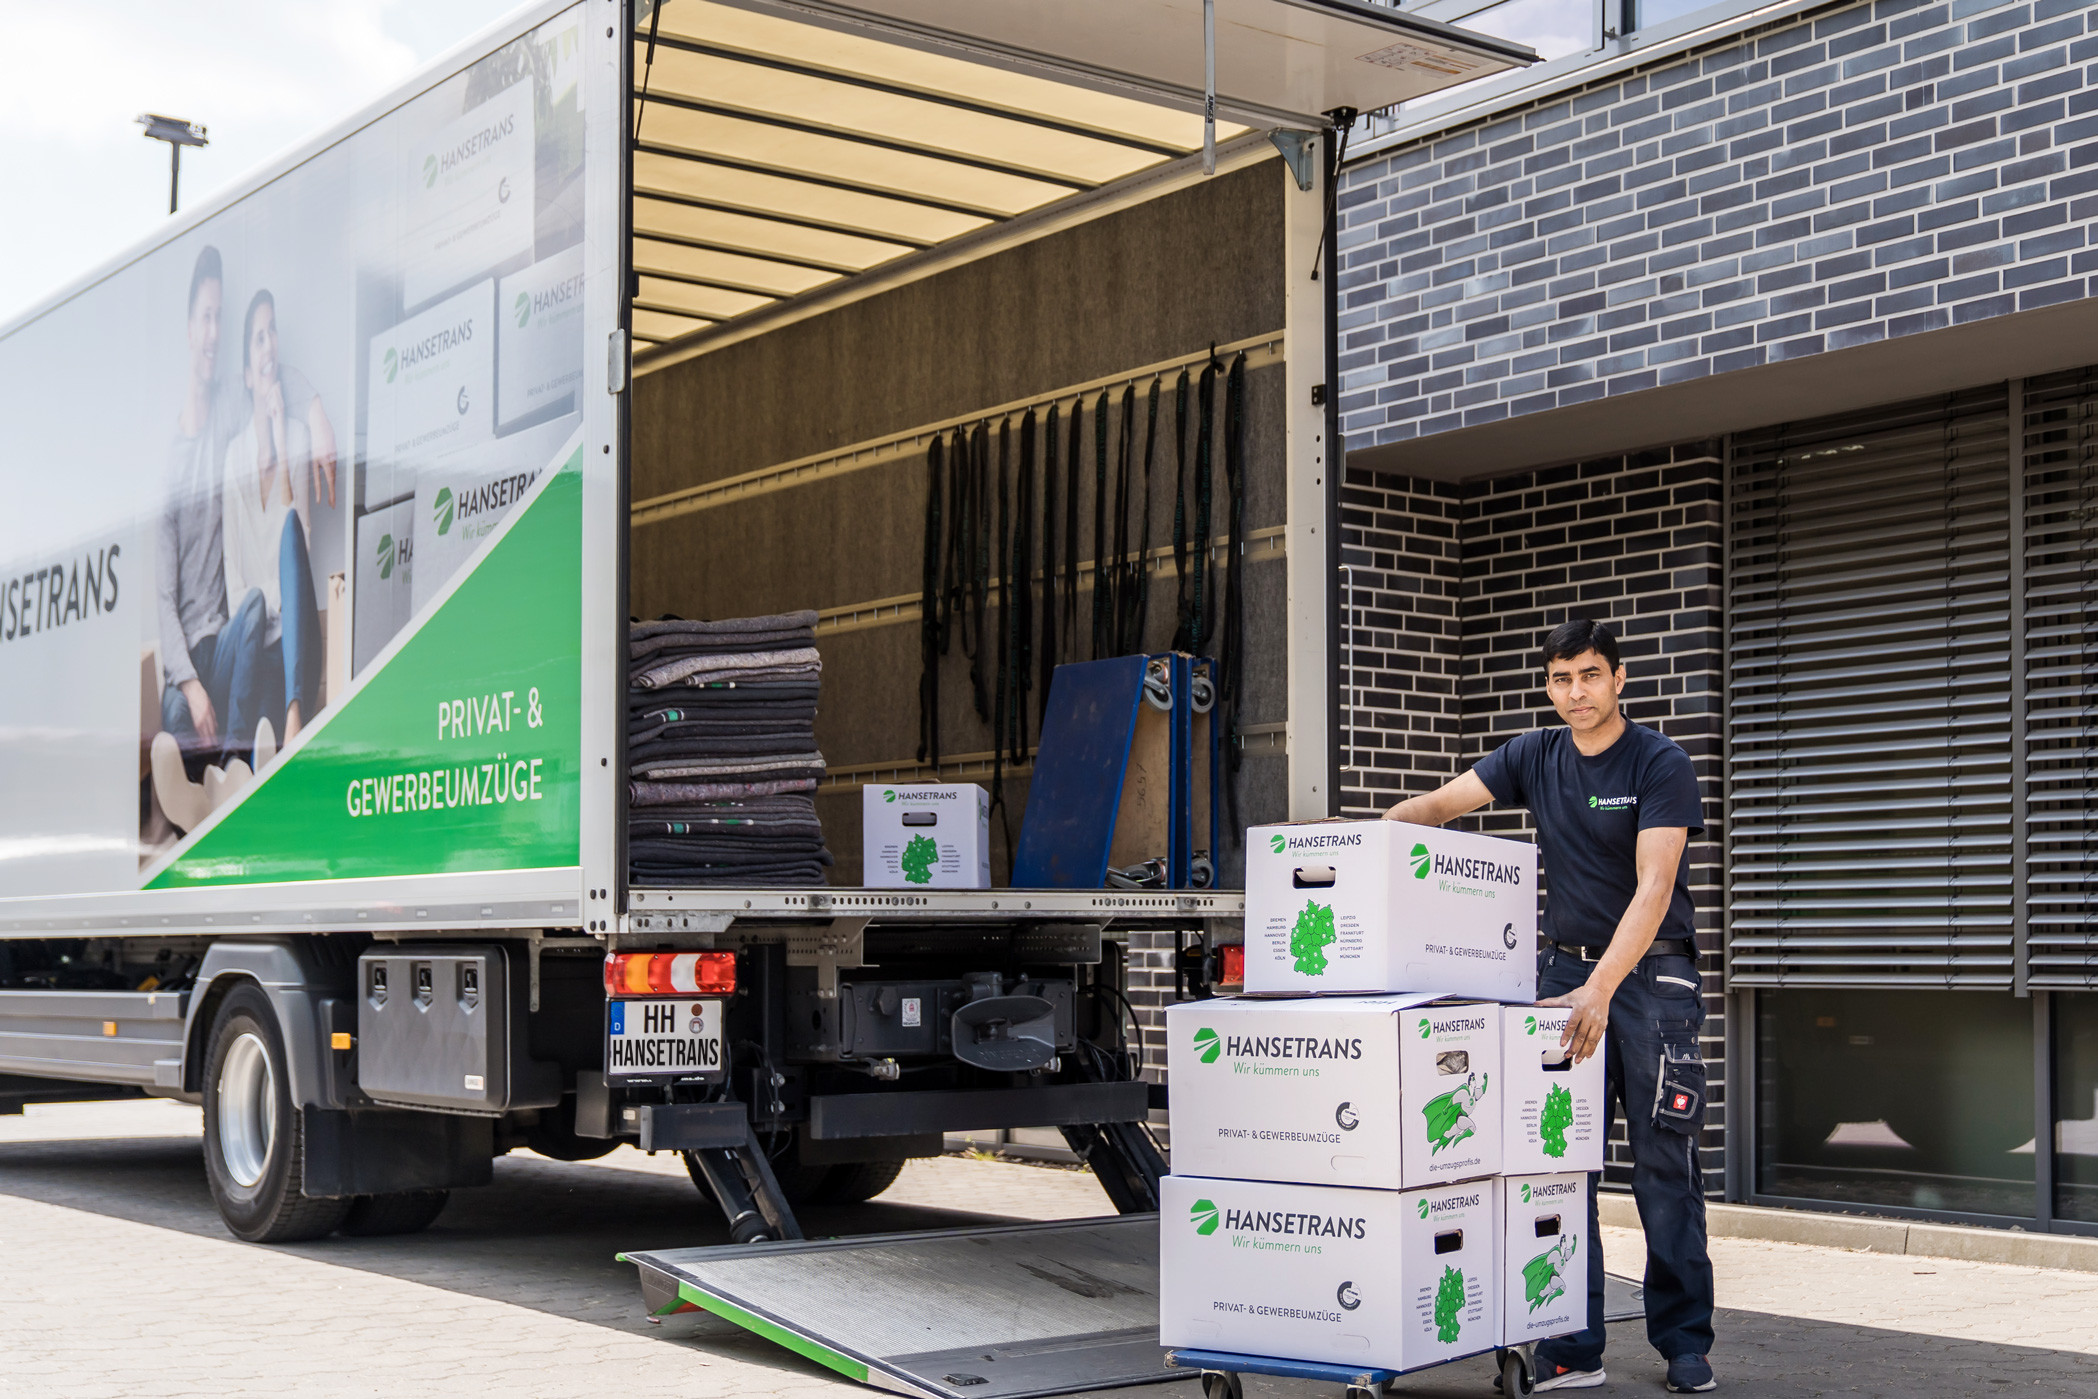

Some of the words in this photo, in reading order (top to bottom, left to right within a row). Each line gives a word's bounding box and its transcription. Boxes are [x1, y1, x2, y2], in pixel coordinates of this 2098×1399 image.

[440, 113, 514, 174] HANSETRANS
[401, 319, 473, 370] HANSETRANS
[458, 467, 542, 520] HANSETRA
[438, 691, 521, 740] PRIVAT-
[527, 686, 543, 729] &
[347, 752, 543, 818] GEWERBEUMZÜGE
[898, 791, 957, 800] HANSETRANS
[1289, 834, 1362, 848] HANSETRANS
[1435, 854, 1520, 885] HANSETRANS
[1439, 880, 1451, 891] Wir
[1452, 883, 1482, 897] kümmern
[1485, 890, 1495, 898] uns
[1425, 944, 1448, 954] PRIVAT-
[1449, 947, 1453, 955] &
[1454, 947, 1506, 961] GEWERBEUMZÜGE
[614, 1022, 621, 1031] D
[644, 1005, 675, 1033] HH
[1433, 1018, 1485, 1033] HANSETRANS
[1539, 1020, 1568, 1031] HANSE
[613, 1038, 719, 1066] HANSETRANS
[1226, 1036, 1362, 1060] HANSETRANS
[1234, 1062, 1250, 1075] Wir
[1253, 1063, 1299, 1076] kümmern
[1302, 1067, 1320, 1077] uns
[1218, 1128, 1250, 1138] PRIVAT-
[1252, 1130, 1258, 1140] &
[1259, 1130, 1341, 1144] GEWERBEUMZÜGE
[1429, 1158, 1481, 1171] die-umzugsprofis.de
[1532, 1182, 1576, 1198] HANSETRANS
[1431, 1194, 1479, 1213] HANSETRANS
[1225, 1209, 1366, 1240] HANSETRANS
[1232, 1235, 1250, 1248] Wir
[1253, 1237, 1301, 1252] kümmern
[1304, 1244, 1322, 1254] uns
[1213, 1302, 1247, 1313] PRIVAT-
[1248, 1304, 1255, 1314] &
[1256, 1305, 1342, 1323] GEWERBEUMZÜGE
